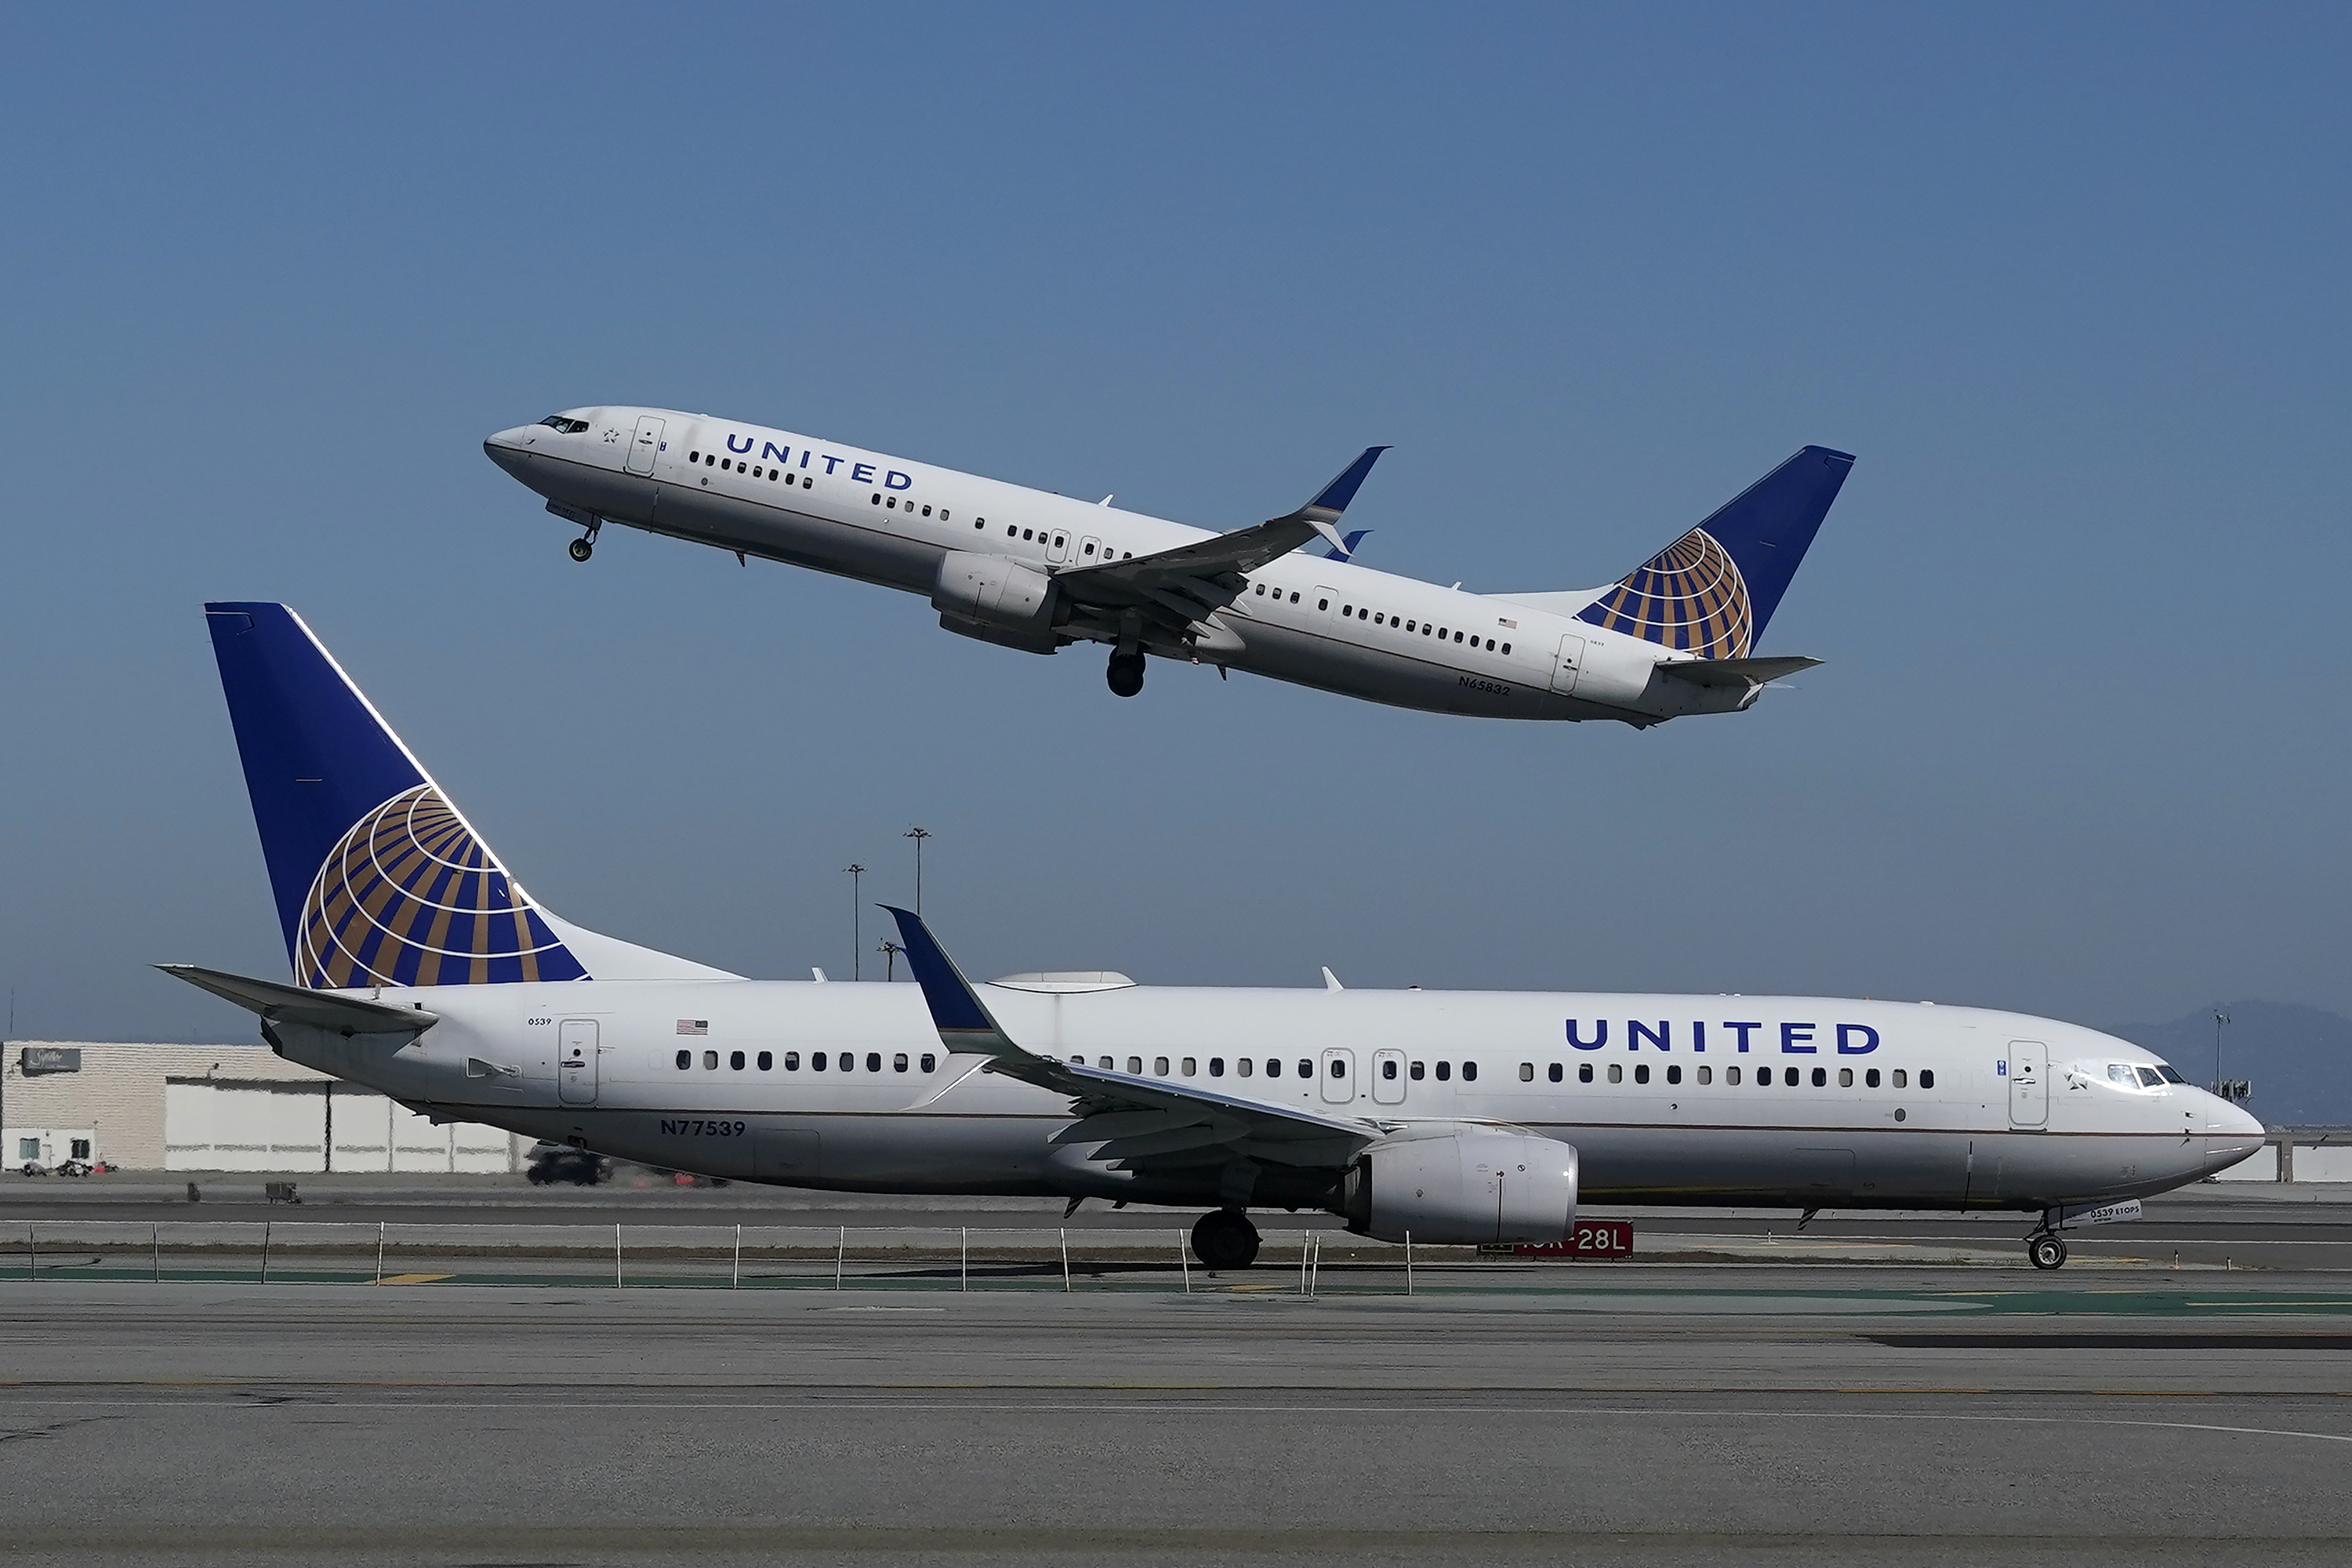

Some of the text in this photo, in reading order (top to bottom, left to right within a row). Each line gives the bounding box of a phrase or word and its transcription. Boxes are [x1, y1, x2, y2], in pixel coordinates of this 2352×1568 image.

[727, 434, 913, 491] UNITED
[1458, 676, 1511, 697] N65832
[1565, 1018, 1880, 1054] UNITED
[660, 1119, 746, 1137] N77539
[2090, 1205, 2140, 1218] 0539 ETOPS
